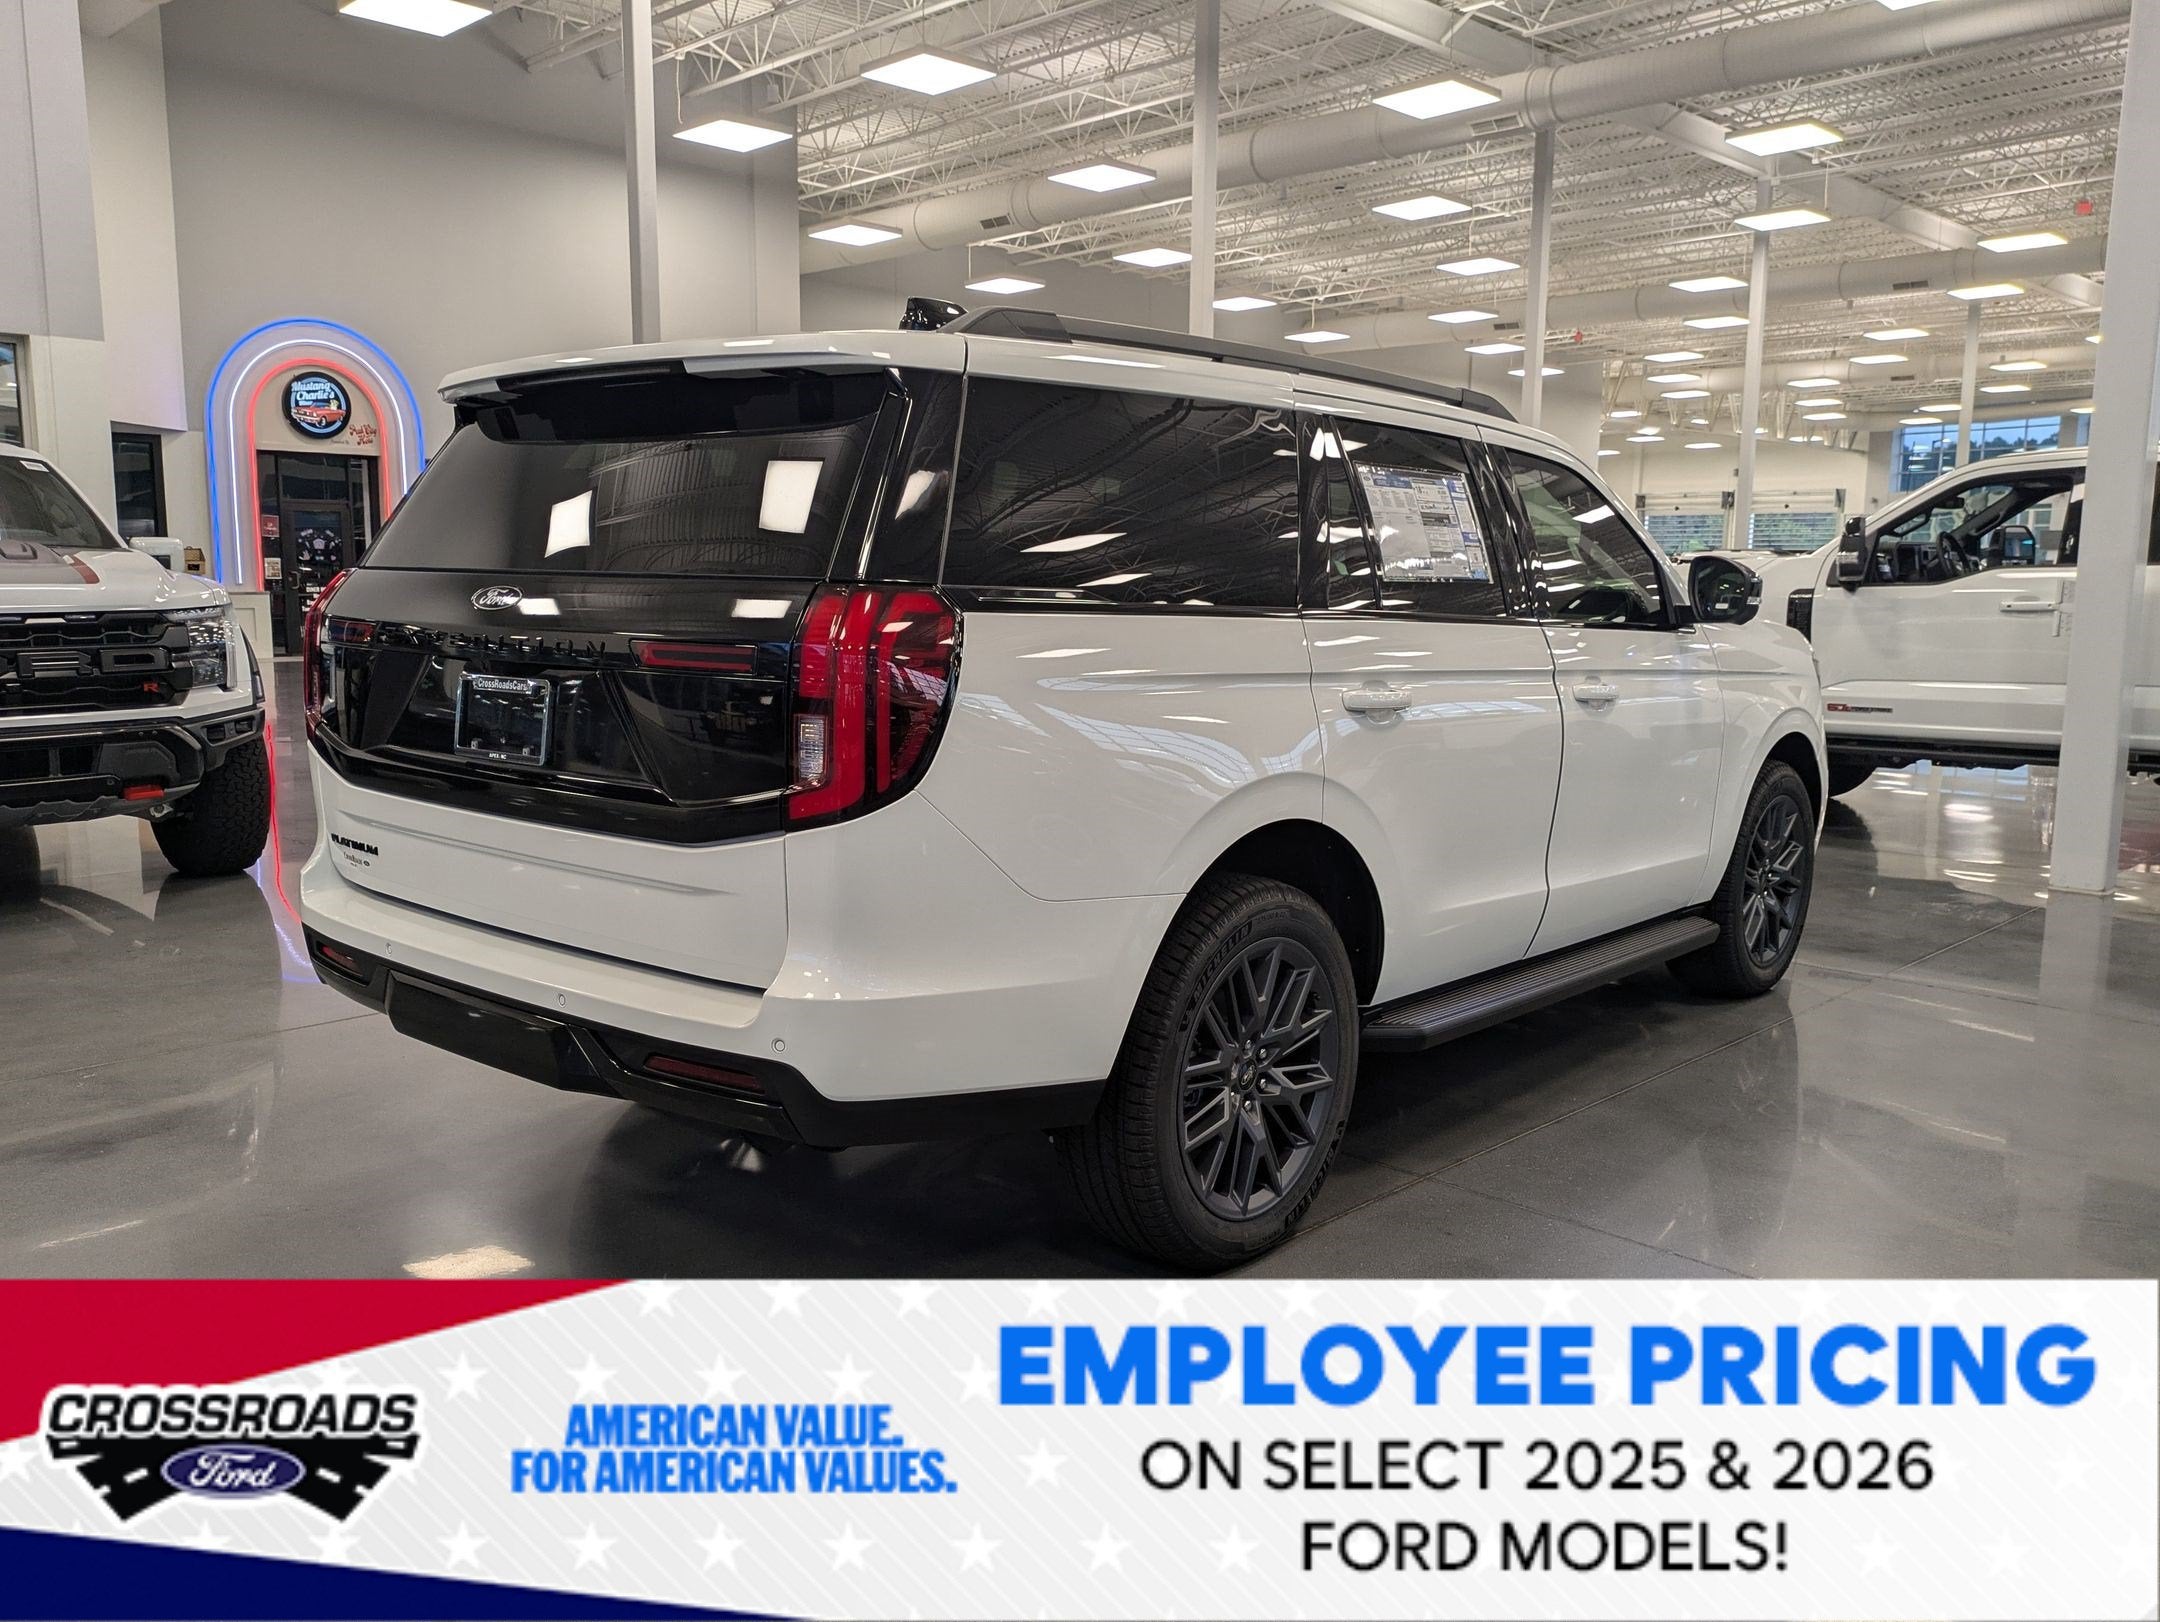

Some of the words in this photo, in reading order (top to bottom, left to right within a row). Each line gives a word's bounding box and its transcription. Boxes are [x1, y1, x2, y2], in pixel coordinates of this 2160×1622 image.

[291, 381, 331, 392] Mustang
[296, 390, 335, 400] Charlie's
[479, 588, 515, 605] Ford
[331, 833, 378, 856] PLATINUM
